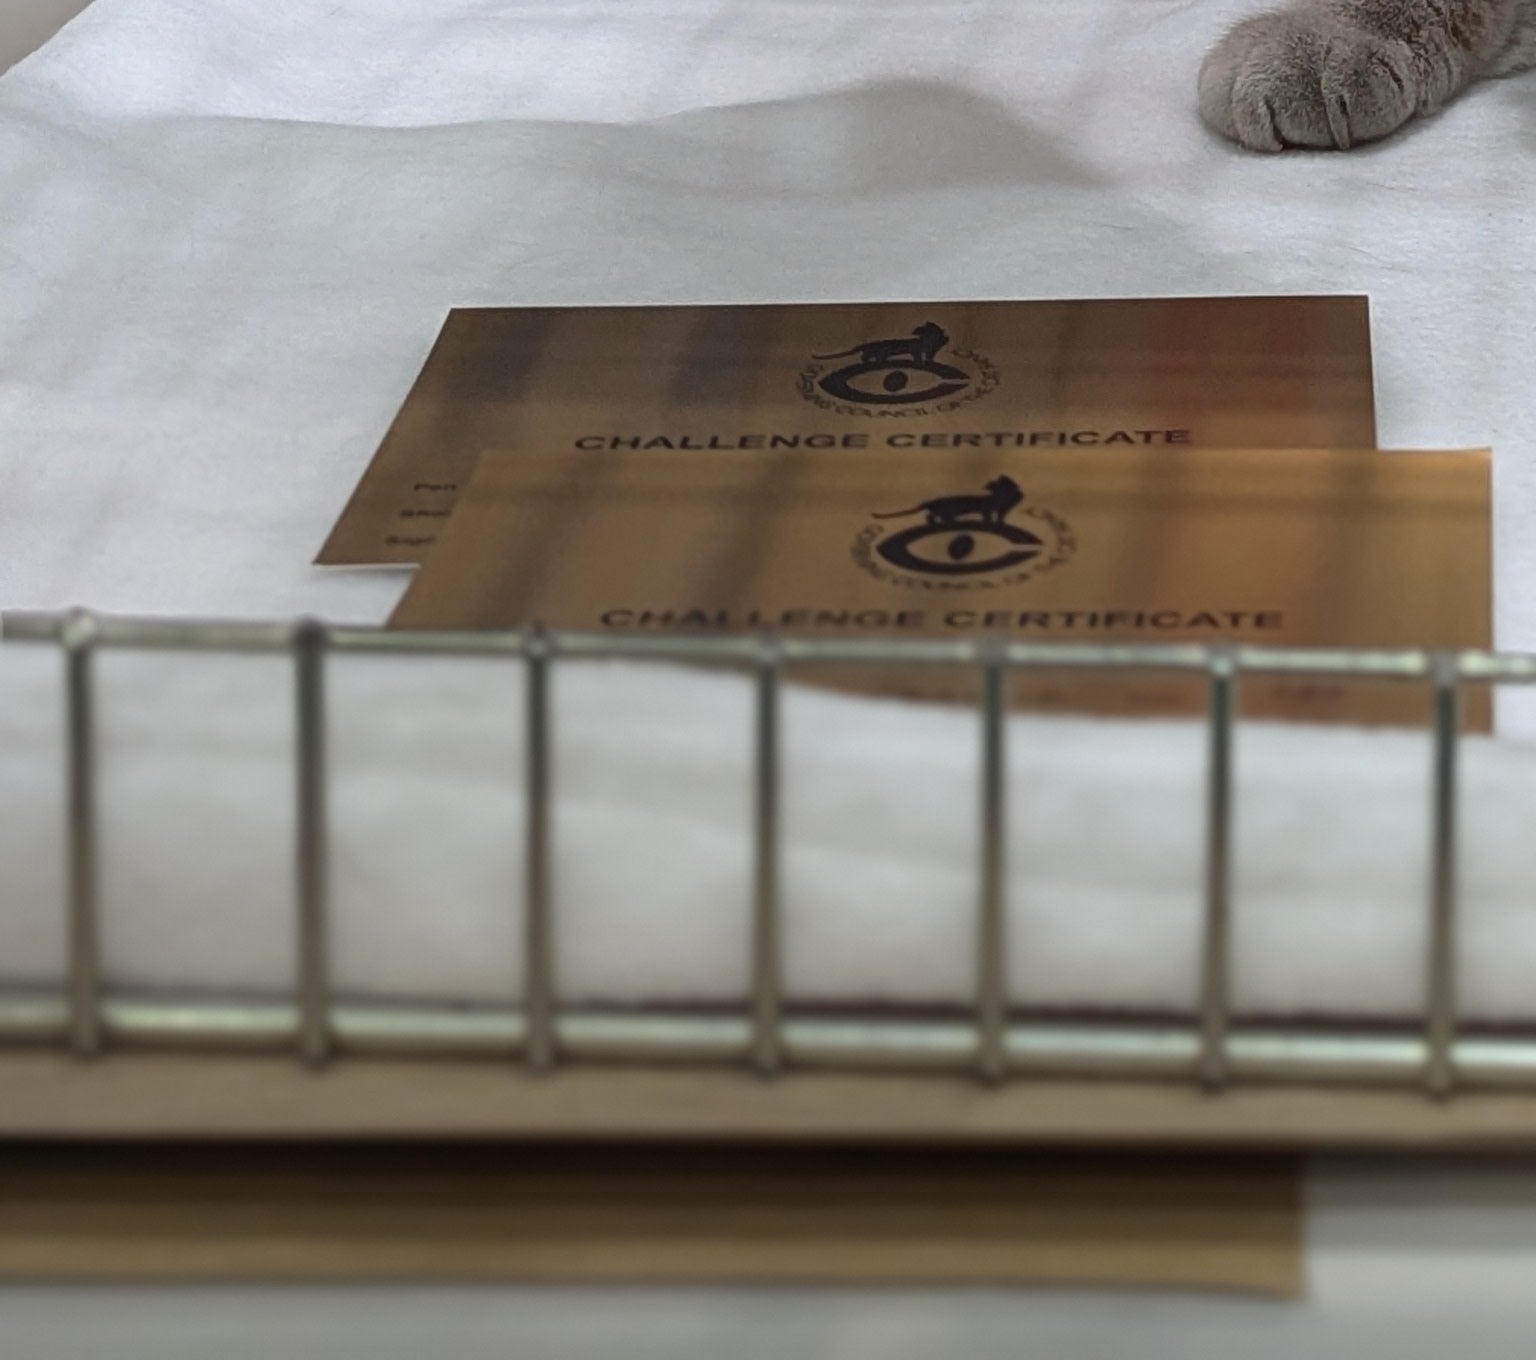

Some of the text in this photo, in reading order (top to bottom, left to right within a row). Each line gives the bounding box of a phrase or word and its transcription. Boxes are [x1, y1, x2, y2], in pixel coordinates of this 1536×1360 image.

[574, 430, 1193, 451] CHALLENGE CERTIFICATE
[600, 609, 1285, 629] CHALLENGE CERTIFICATE
